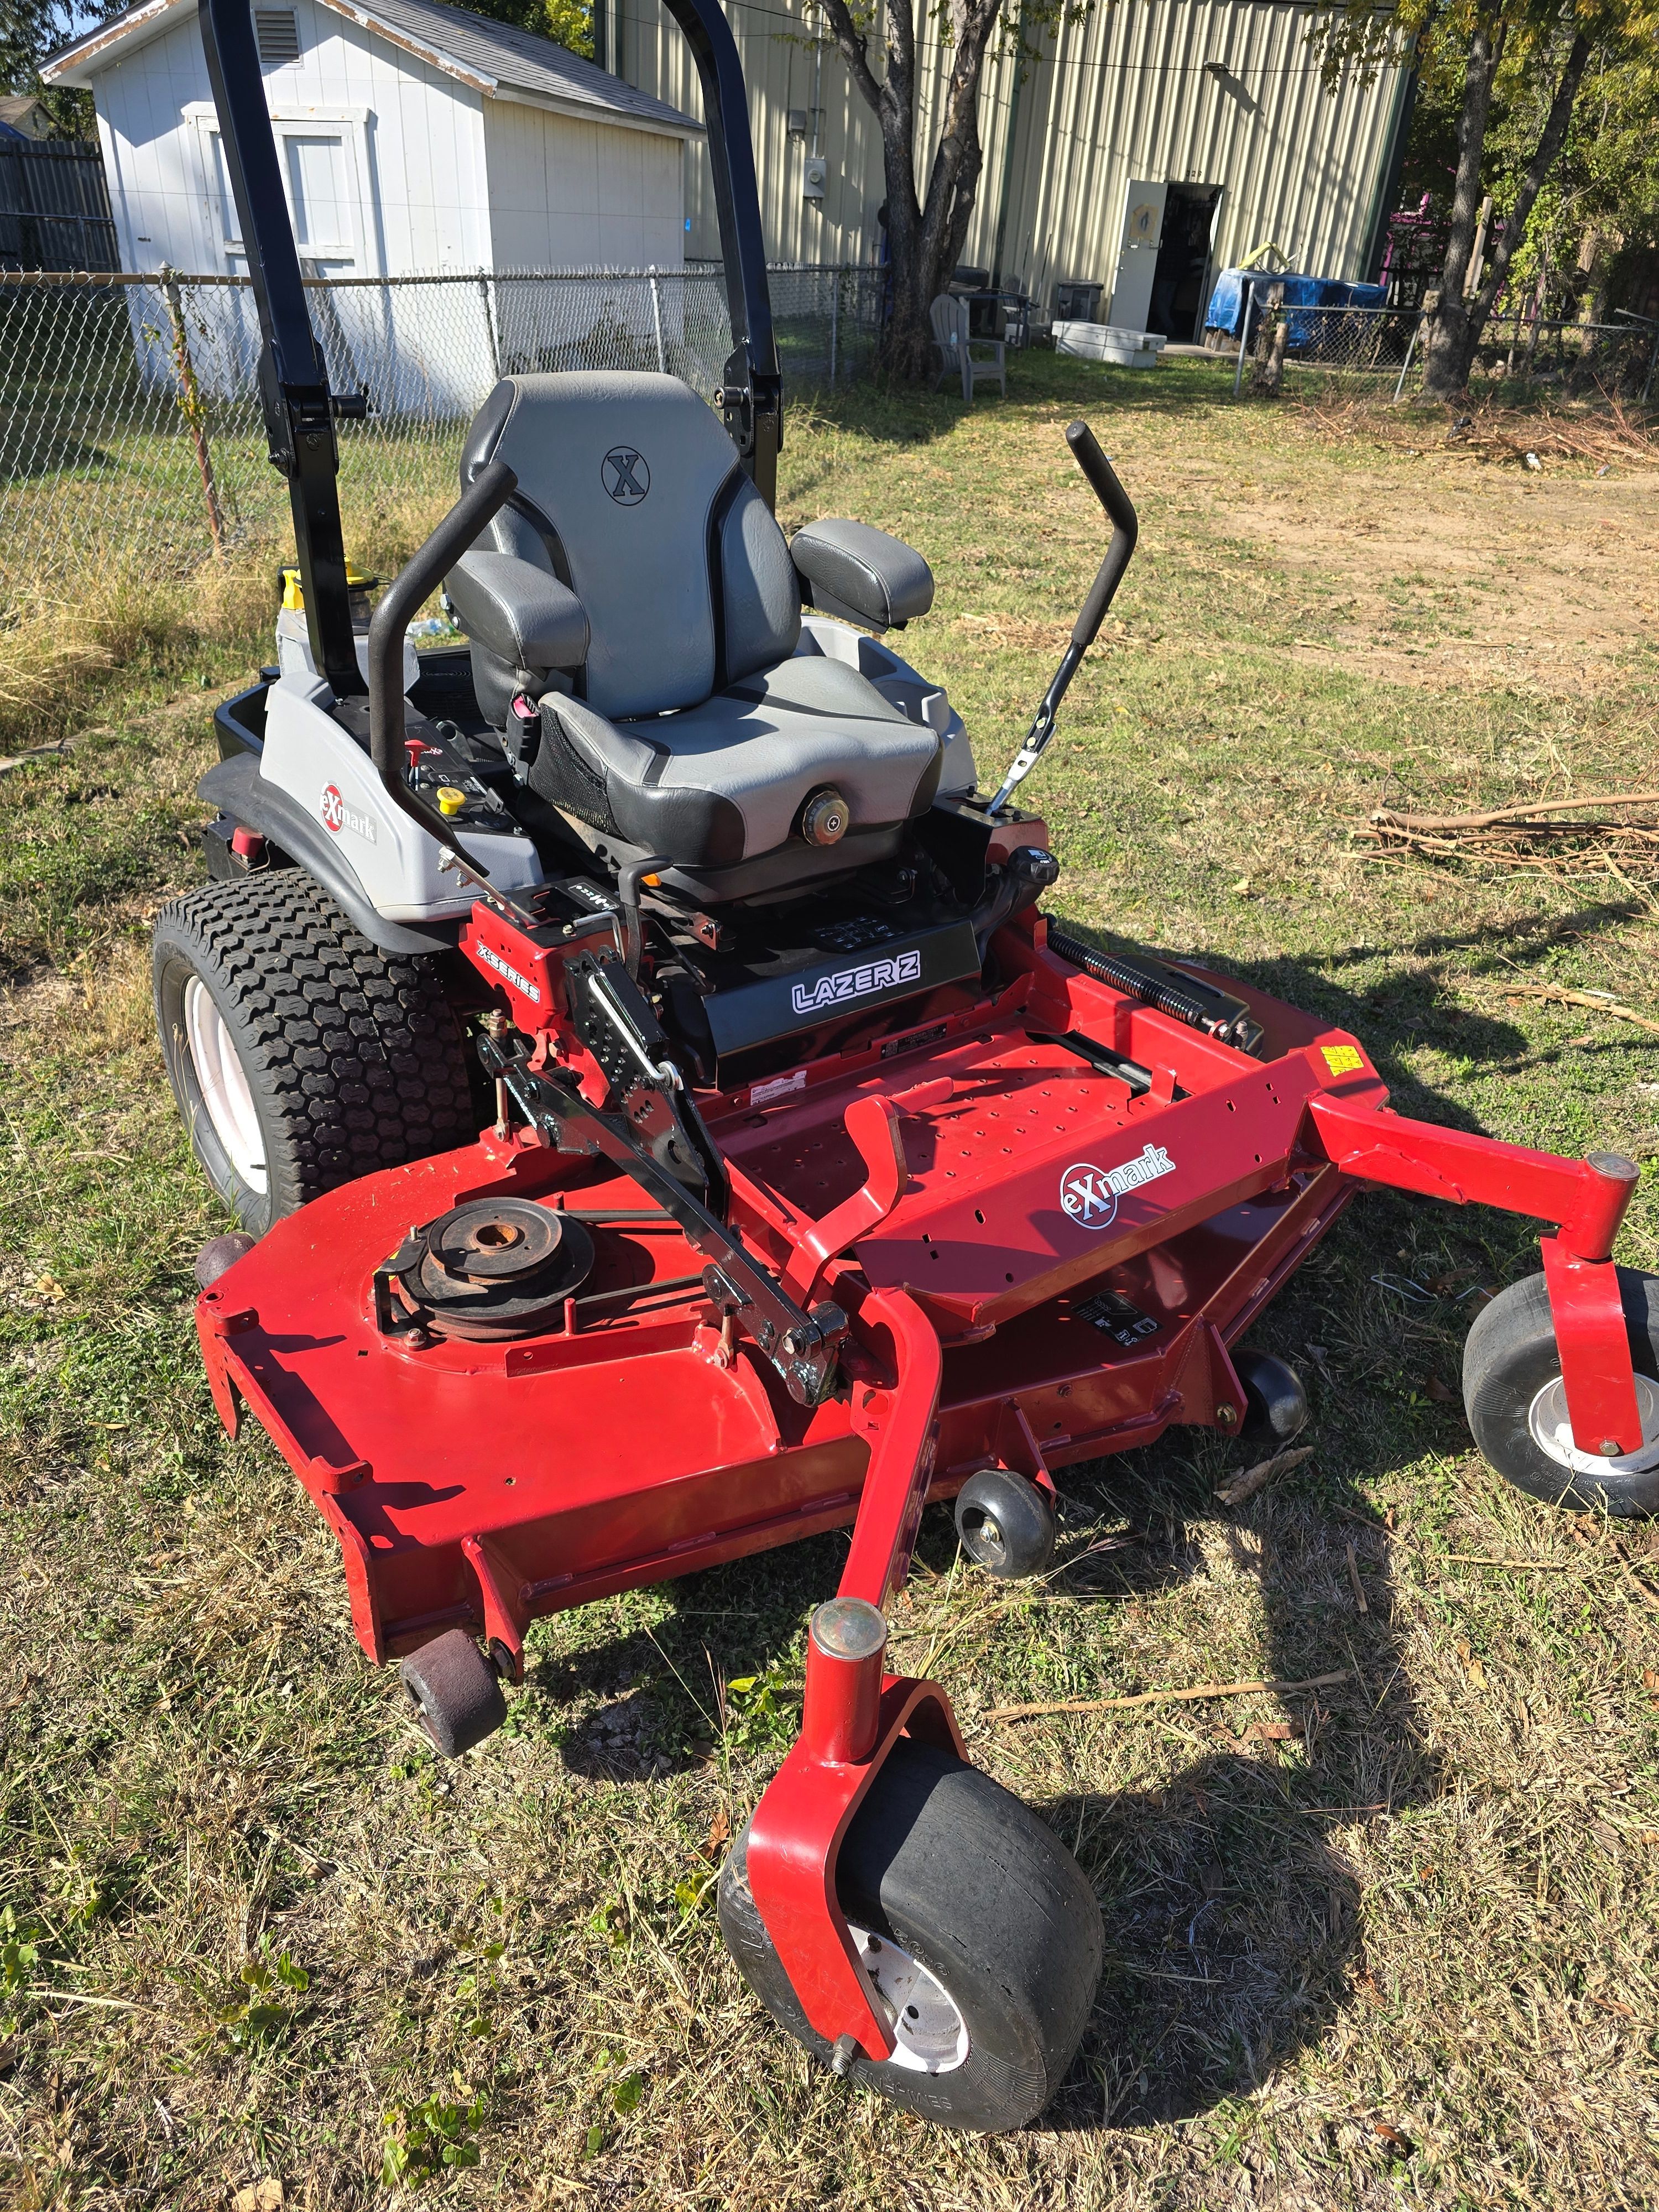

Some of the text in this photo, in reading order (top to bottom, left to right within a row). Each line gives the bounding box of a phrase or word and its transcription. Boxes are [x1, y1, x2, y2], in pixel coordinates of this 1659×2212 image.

[607, 454, 645, 497] X
[320, 790, 376, 843] eXmark
[477, 941, 539, 1002] X-SERIES
[794, 952, 919, 1011] LAZER Z
[1062, 1145, 1174, 1221] eXmark
